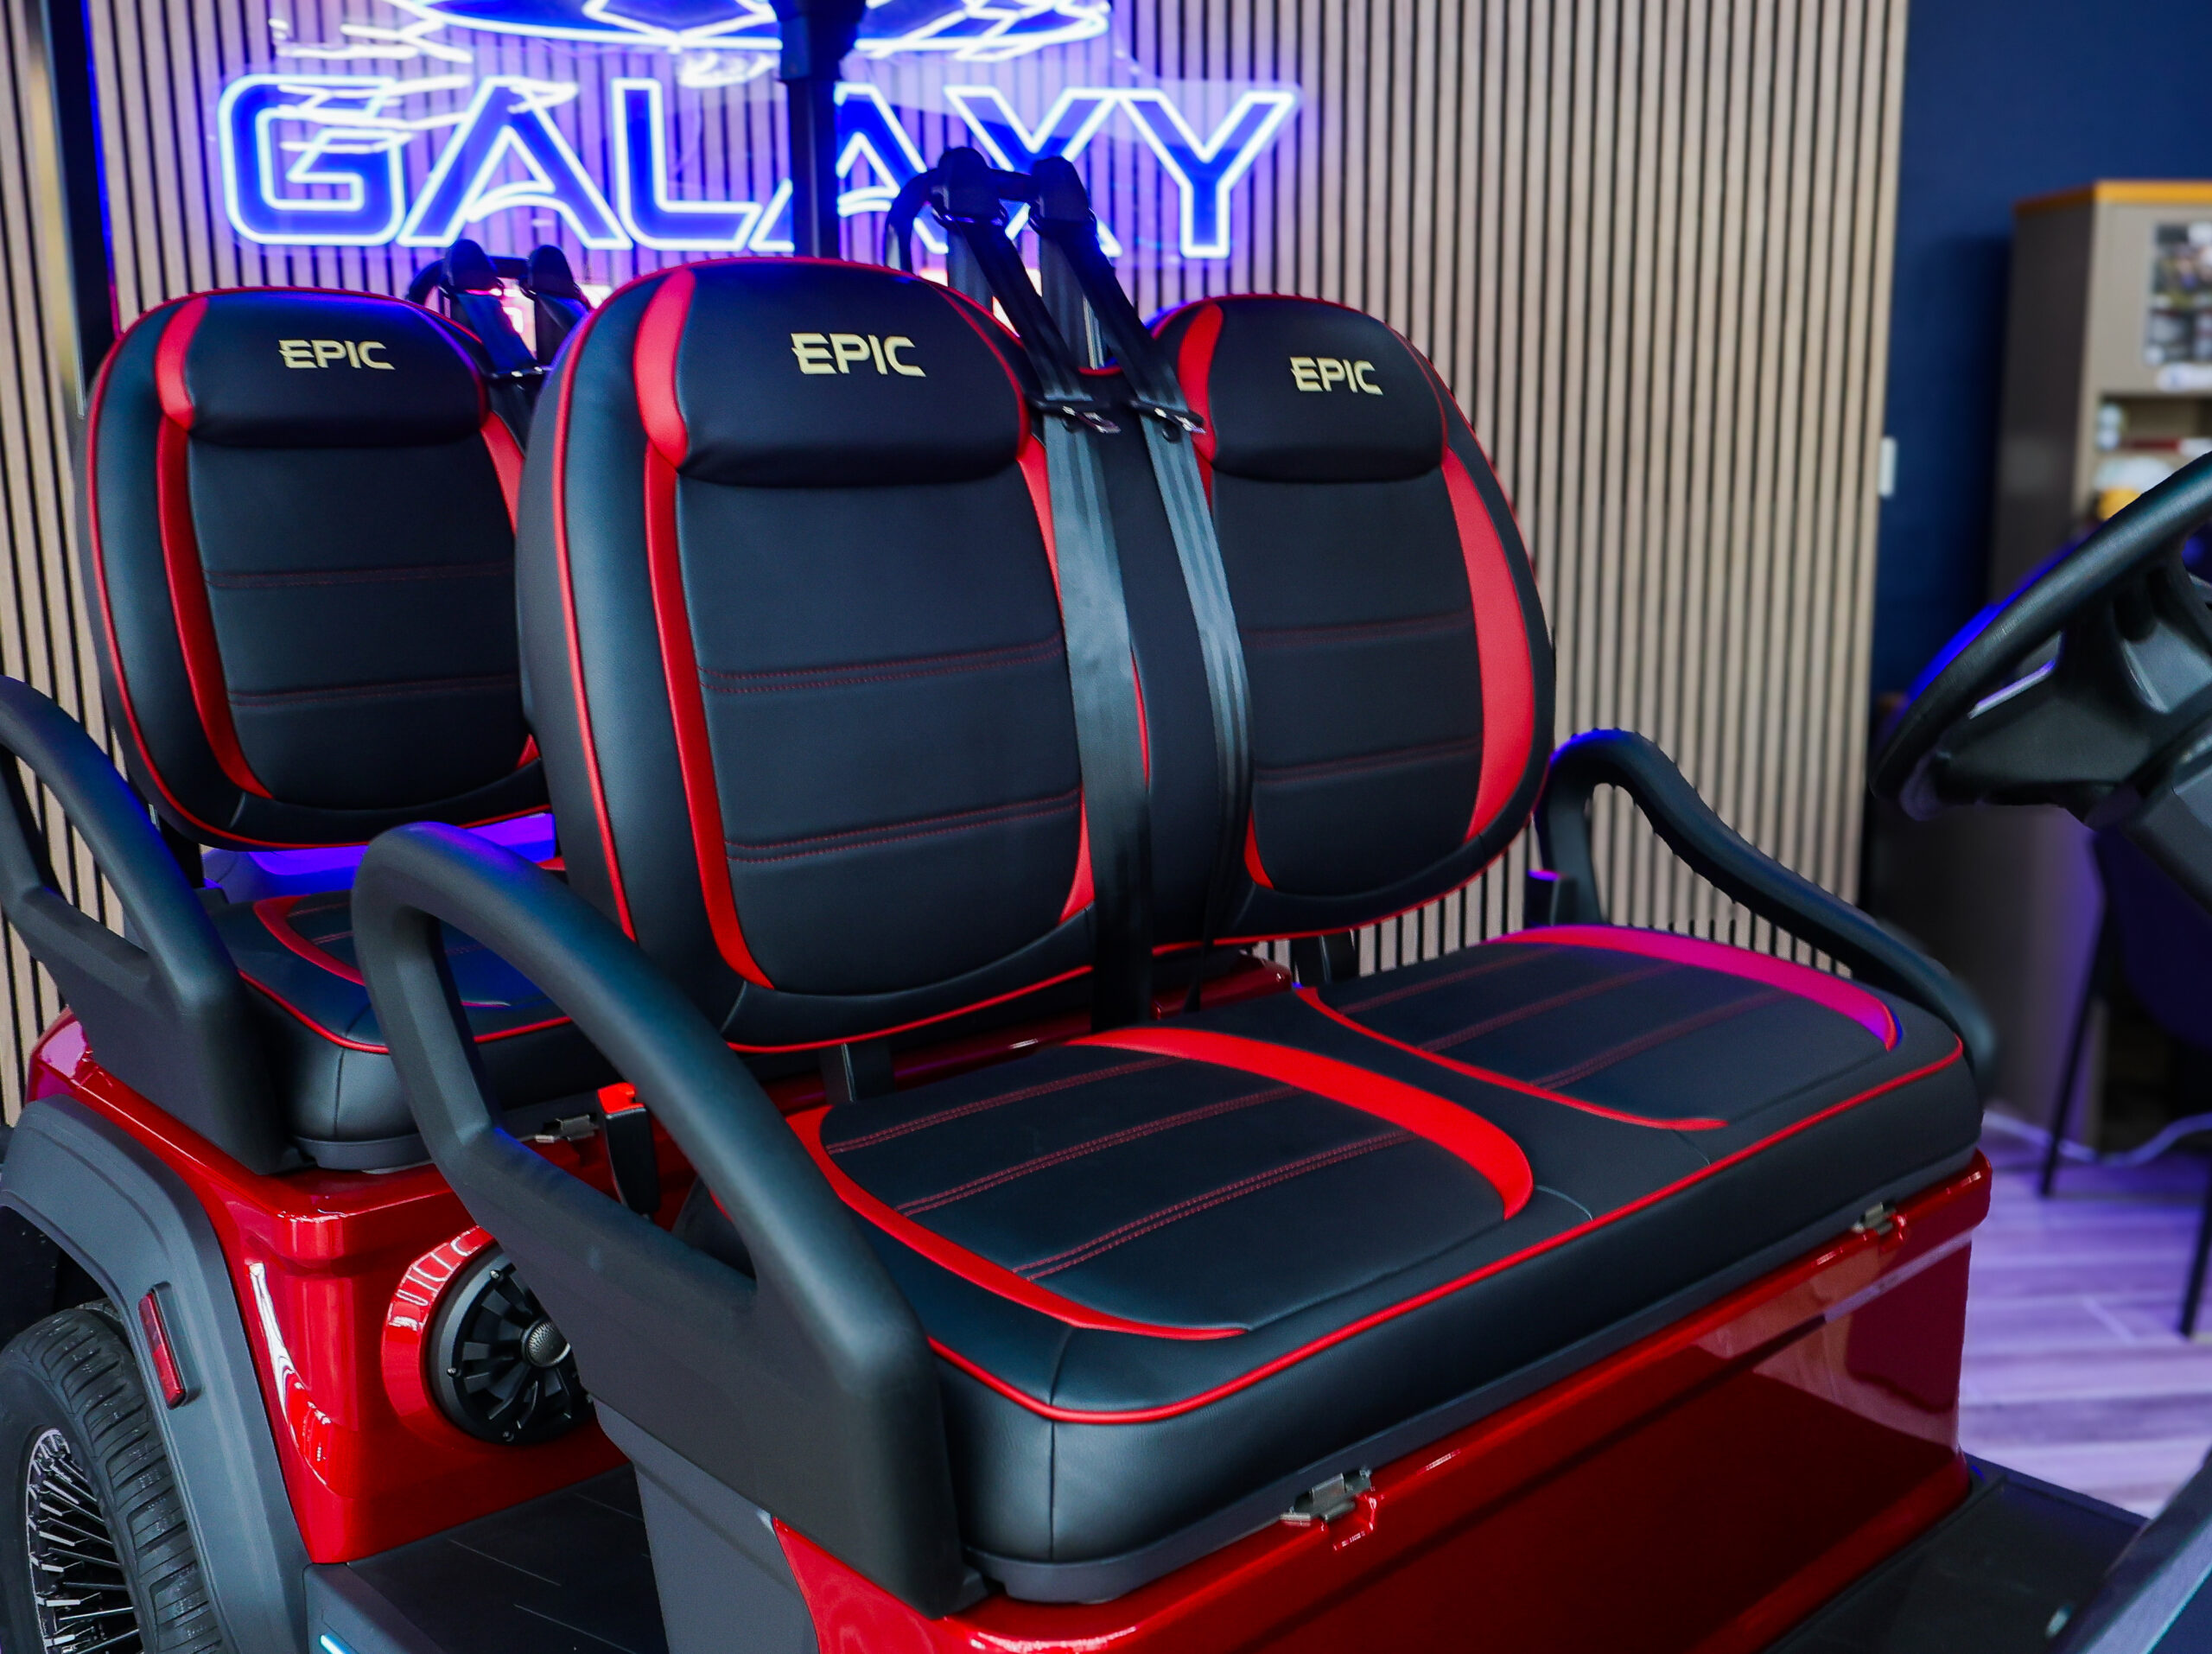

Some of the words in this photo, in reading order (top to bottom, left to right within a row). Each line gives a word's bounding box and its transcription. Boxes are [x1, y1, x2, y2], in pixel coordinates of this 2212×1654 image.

[219, 74, 1296, 259] GALAXY
[279, 339, 395, 370] EPIC
[791, 333, 926, 378] EPIC
[1290, 356, 1383, 396] EPIC
